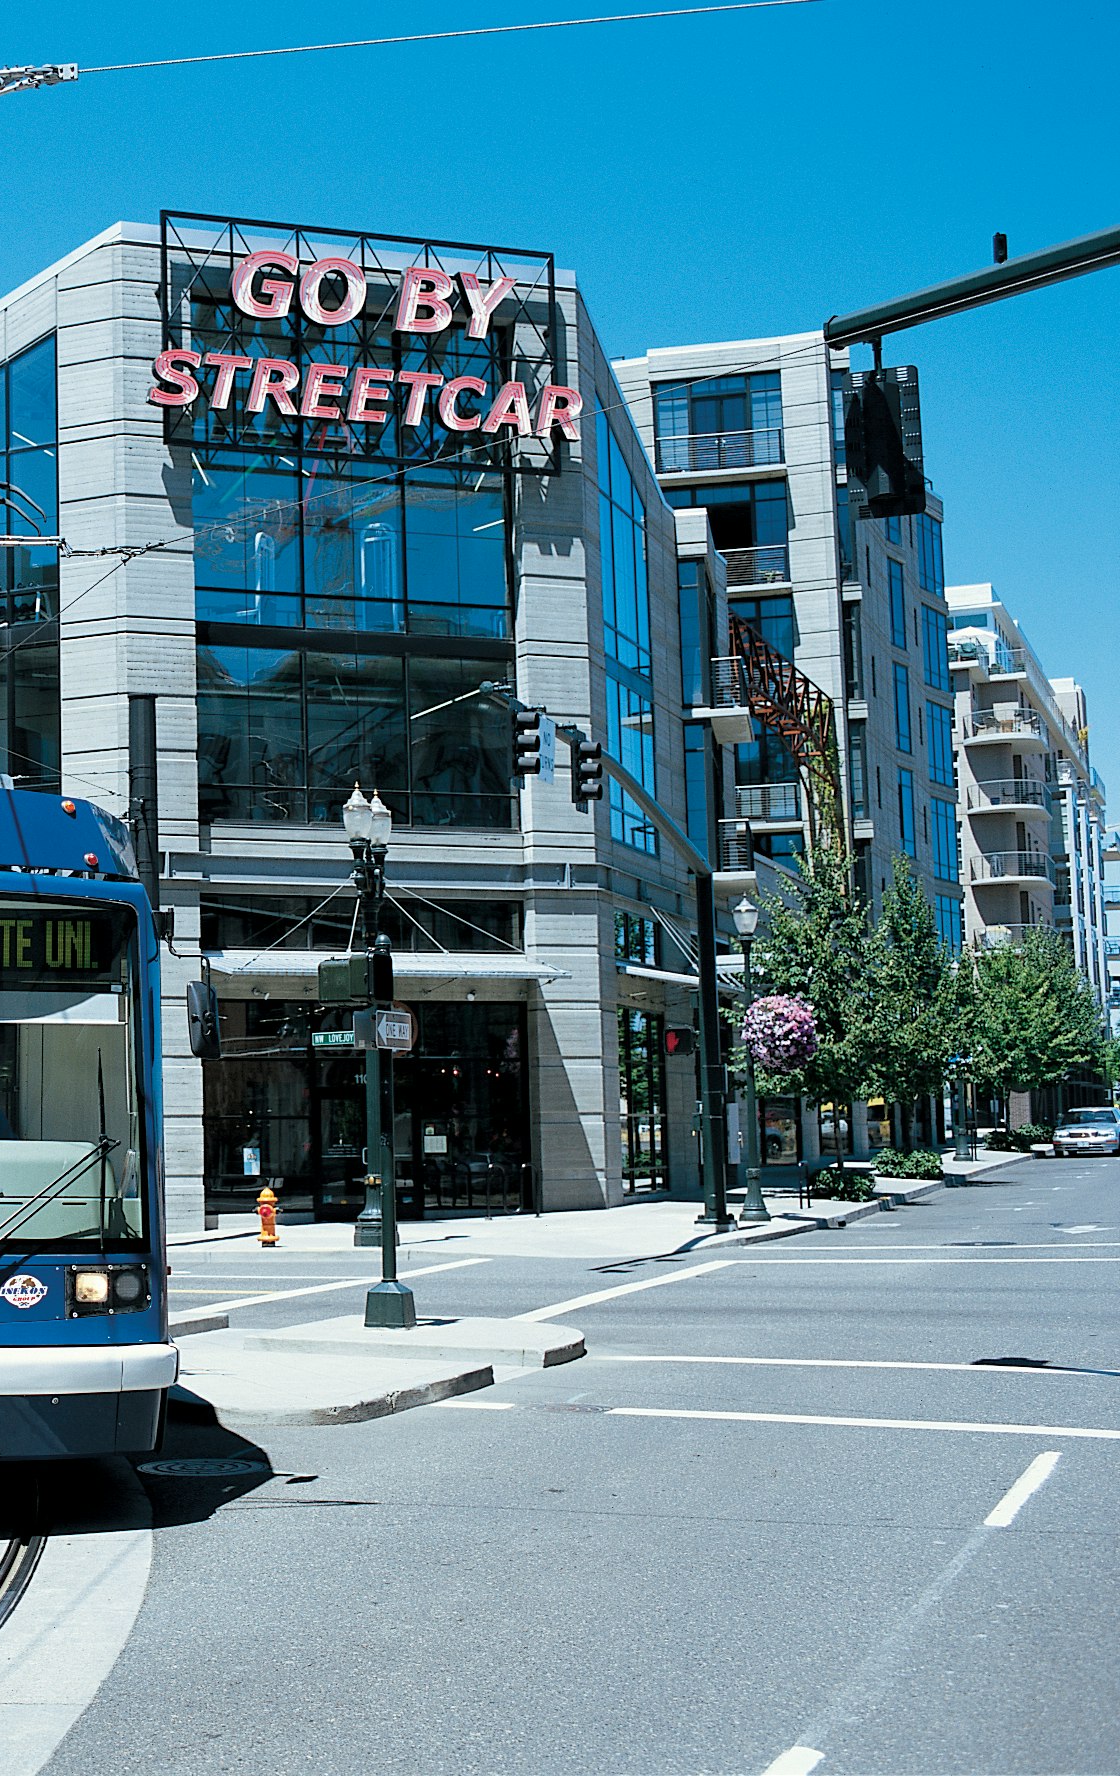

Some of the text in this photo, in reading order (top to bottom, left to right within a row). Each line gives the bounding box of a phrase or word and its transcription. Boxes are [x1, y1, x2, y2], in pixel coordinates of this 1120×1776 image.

[231, 249, 518, 340] GO BY
[146, 348, 583, 442] STREETCAR
[543, 731, 551, 746] NO
[45, 920, 99, 969] UNI.
[314, 1033, 354, 1043] NW LOVEJOY
[385, 1023, 409, 1038] ONE WAY
